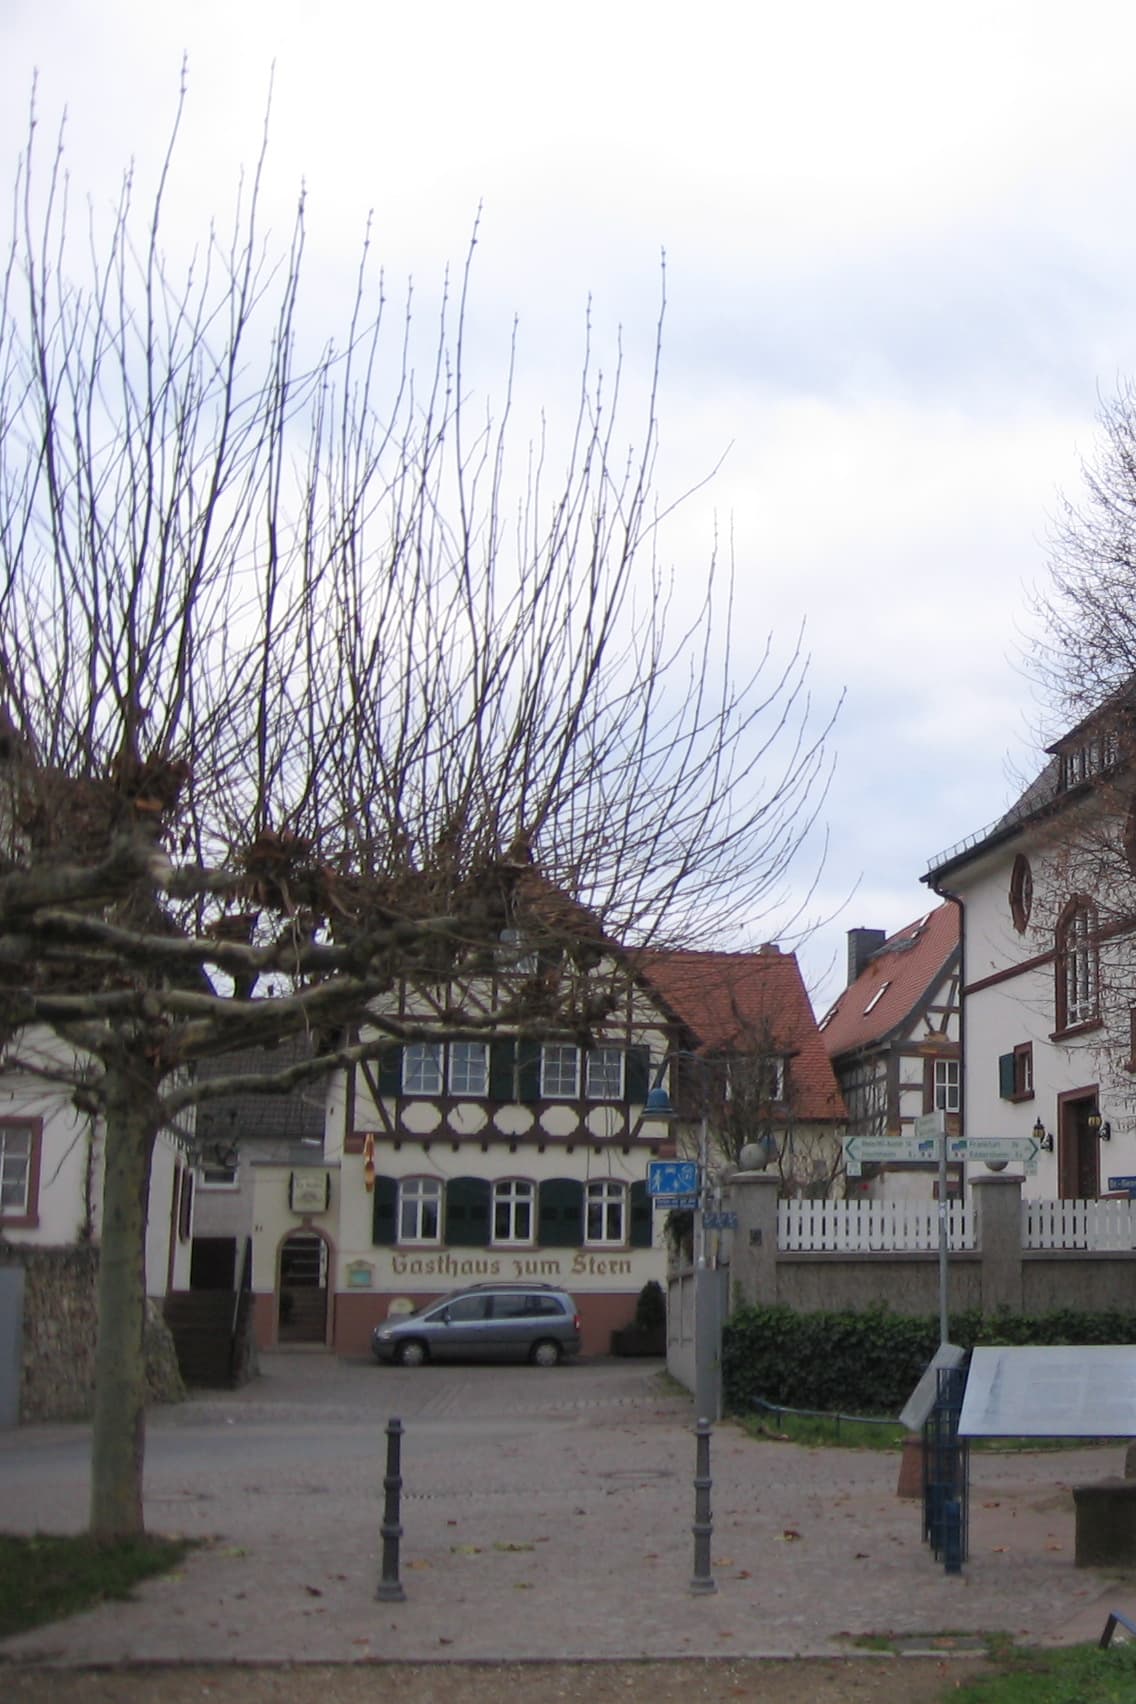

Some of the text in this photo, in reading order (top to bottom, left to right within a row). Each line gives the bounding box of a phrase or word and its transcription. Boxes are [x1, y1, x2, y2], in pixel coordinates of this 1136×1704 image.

[391, 1252, 632, 1277] Gasthaus zum Stern
